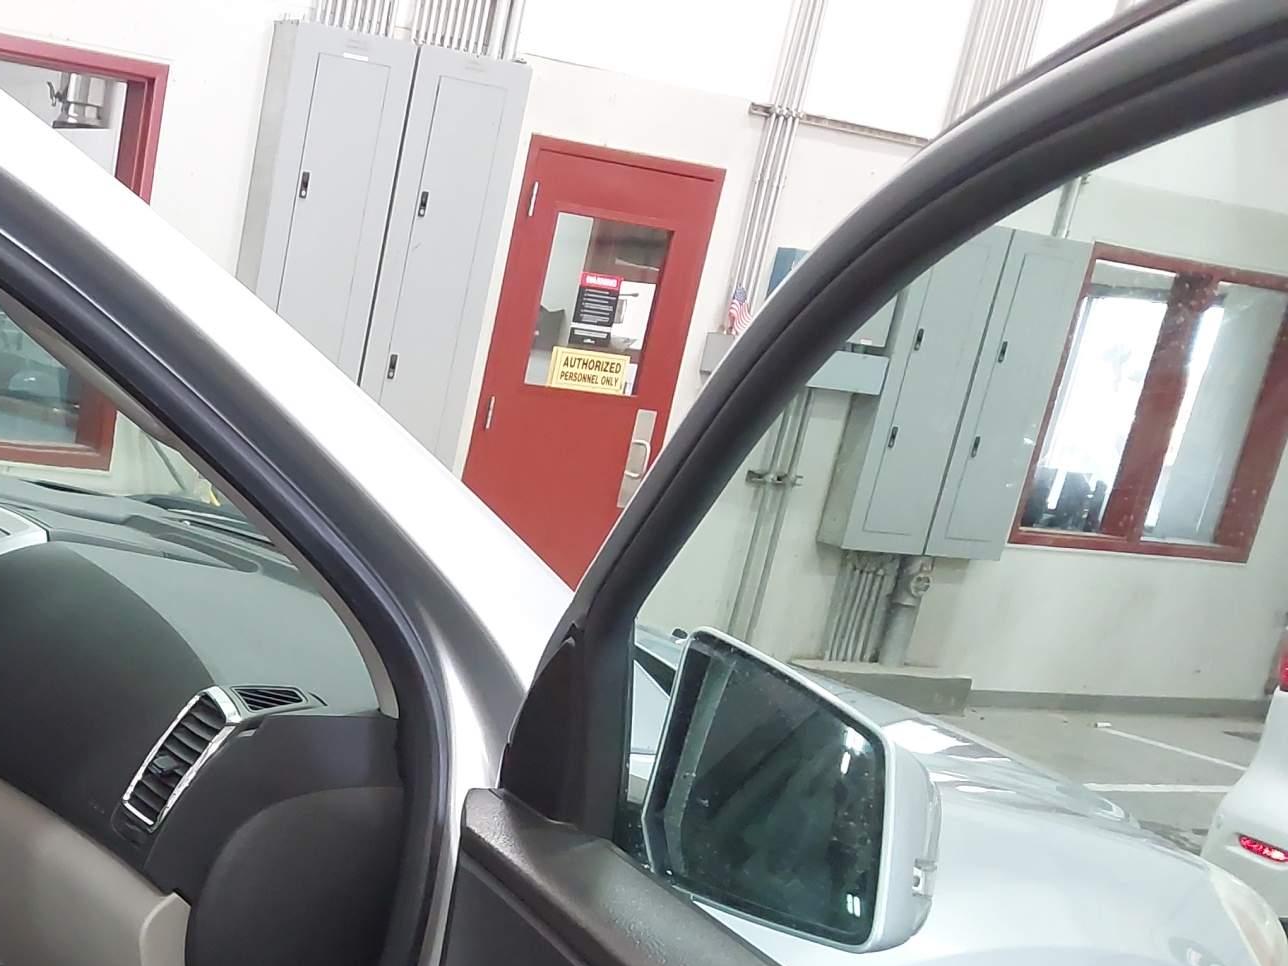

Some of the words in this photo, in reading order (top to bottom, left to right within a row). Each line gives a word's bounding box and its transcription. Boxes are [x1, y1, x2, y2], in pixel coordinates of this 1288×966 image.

[562, 356, 621, 374] AUTHORIZED
[560, 371, 600, 385] PERSONNEL
[601, 375, 619, 387] ONLY
